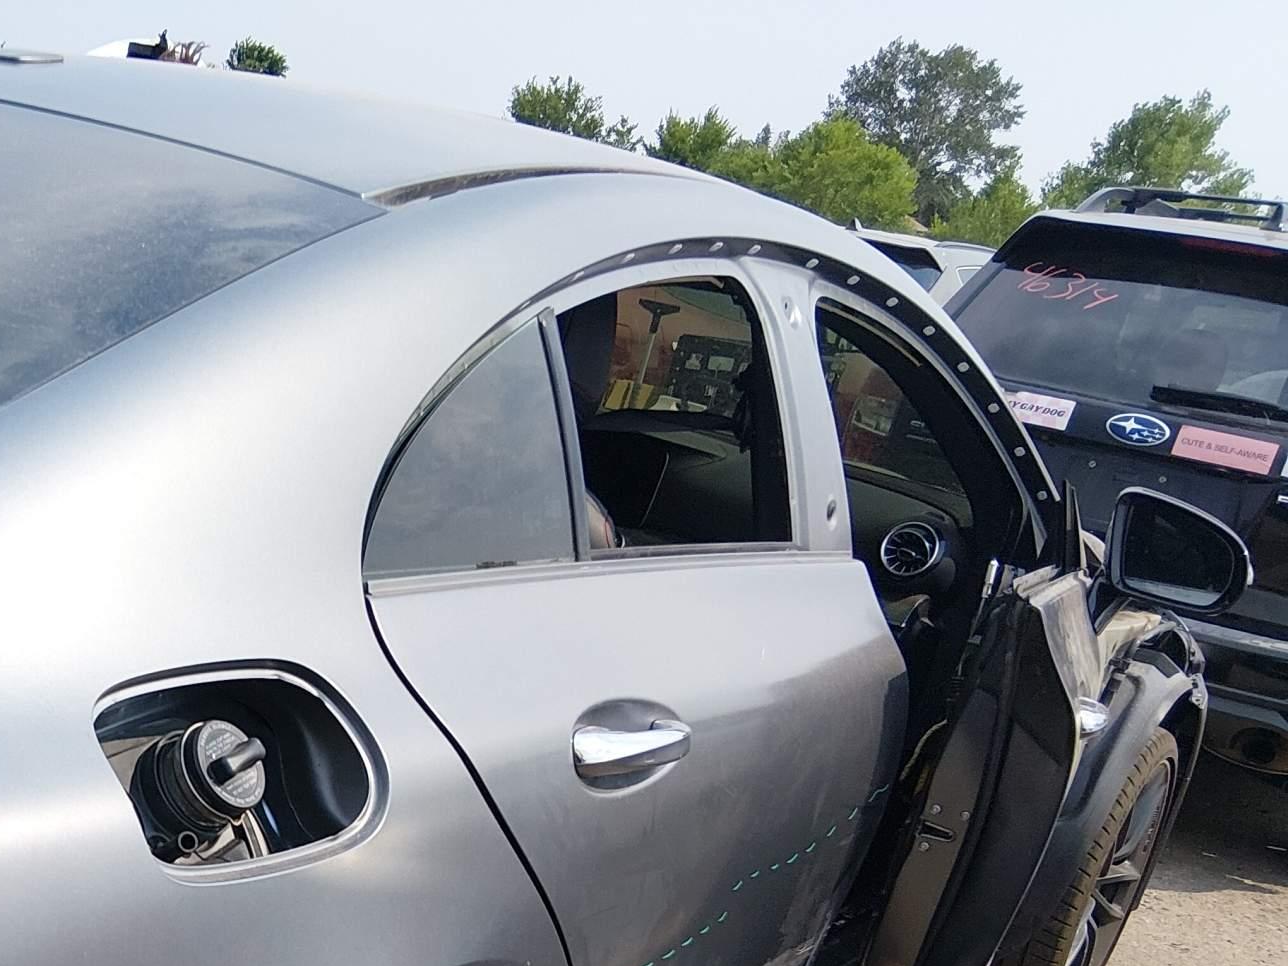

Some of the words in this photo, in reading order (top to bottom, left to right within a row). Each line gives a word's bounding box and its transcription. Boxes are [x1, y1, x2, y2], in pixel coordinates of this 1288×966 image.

[1017, 262, 1119, 310] 46314
[1043, 407, 1066, 417] DOG
[1181, 438, 1205, 449] CUTE
[1205, 441, 1212, 450] &
[1214, 444, 1270, 462] SELF-AWARE
